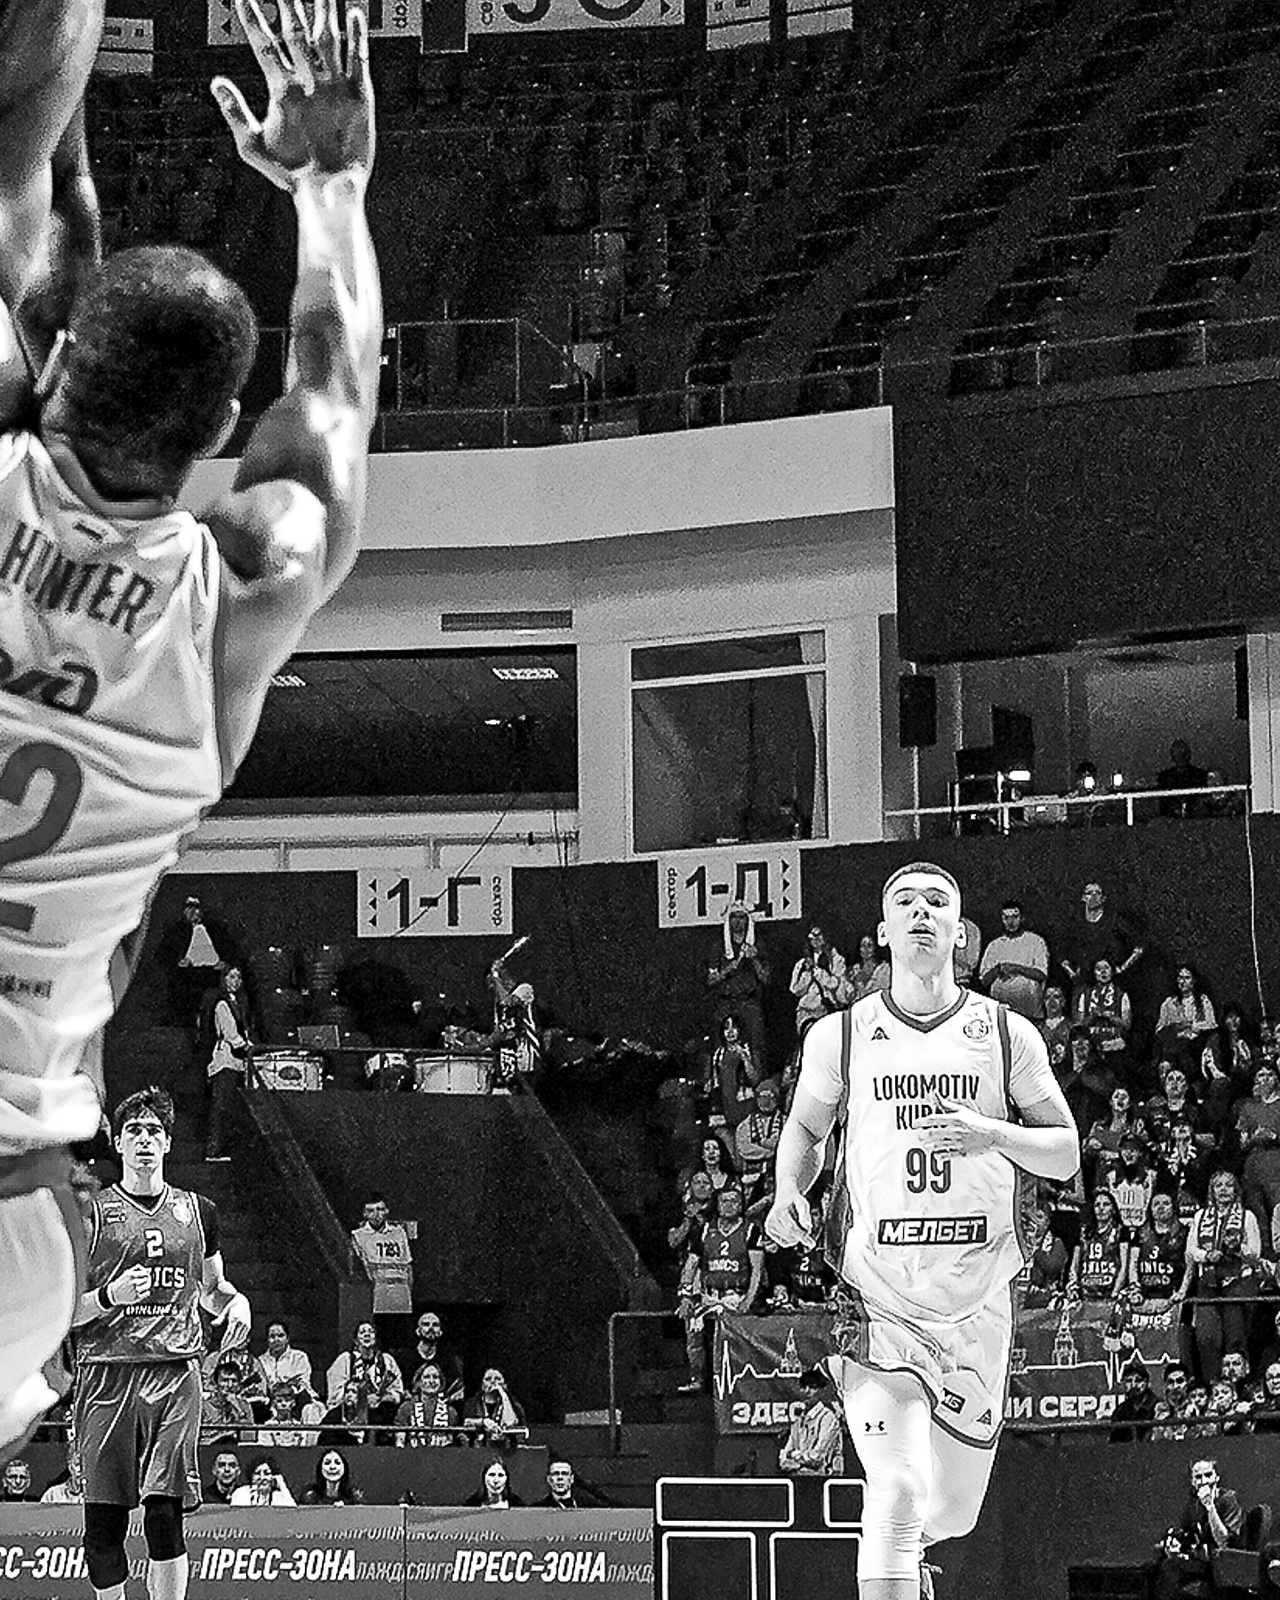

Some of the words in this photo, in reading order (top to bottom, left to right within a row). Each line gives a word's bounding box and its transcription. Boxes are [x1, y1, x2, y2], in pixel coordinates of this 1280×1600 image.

[387, 877, 482, 929] 1-Г
[873, 1074, 980, 1101] LOKOMOTIV
[144, 1228, 165, 1257] 2
[720, 1240, 730, 1256] 2
[153, 1266, 185, 1289] ICS
[799, 1256, 810, 1272] 2
[732, 1399, 805, 1424] ЗДЕС
[1039, 1395, 1124, 1418] СЕРД
[200, 1548, 356, 1580] ПРЕСС-ЗОНА
[452, 1551, 606, 1583] ПРЕСС-ЗОНА
